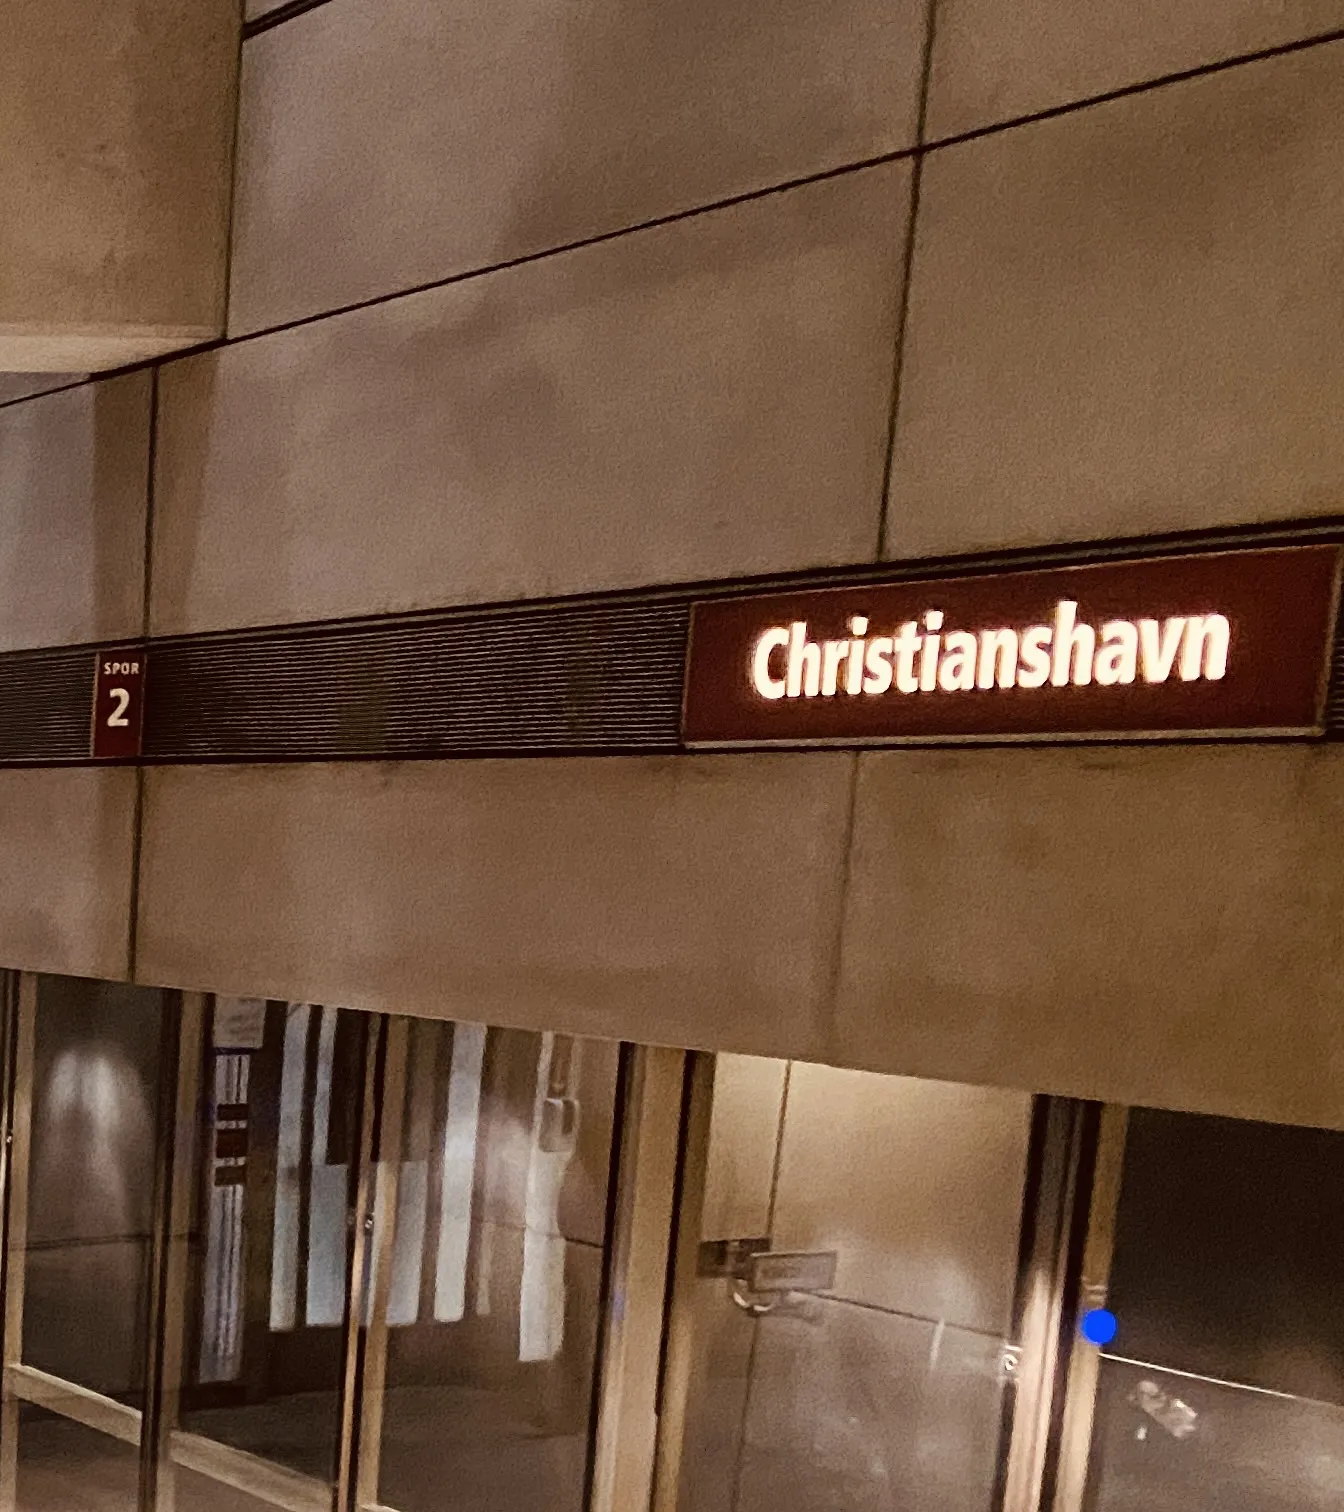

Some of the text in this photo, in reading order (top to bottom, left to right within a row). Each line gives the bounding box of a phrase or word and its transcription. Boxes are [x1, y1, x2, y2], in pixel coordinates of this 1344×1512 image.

[103, 661, 140, 675] SPOR
[751, 599, 1231, 700] Christianshavn
[106, 687, 130, 727] 2
